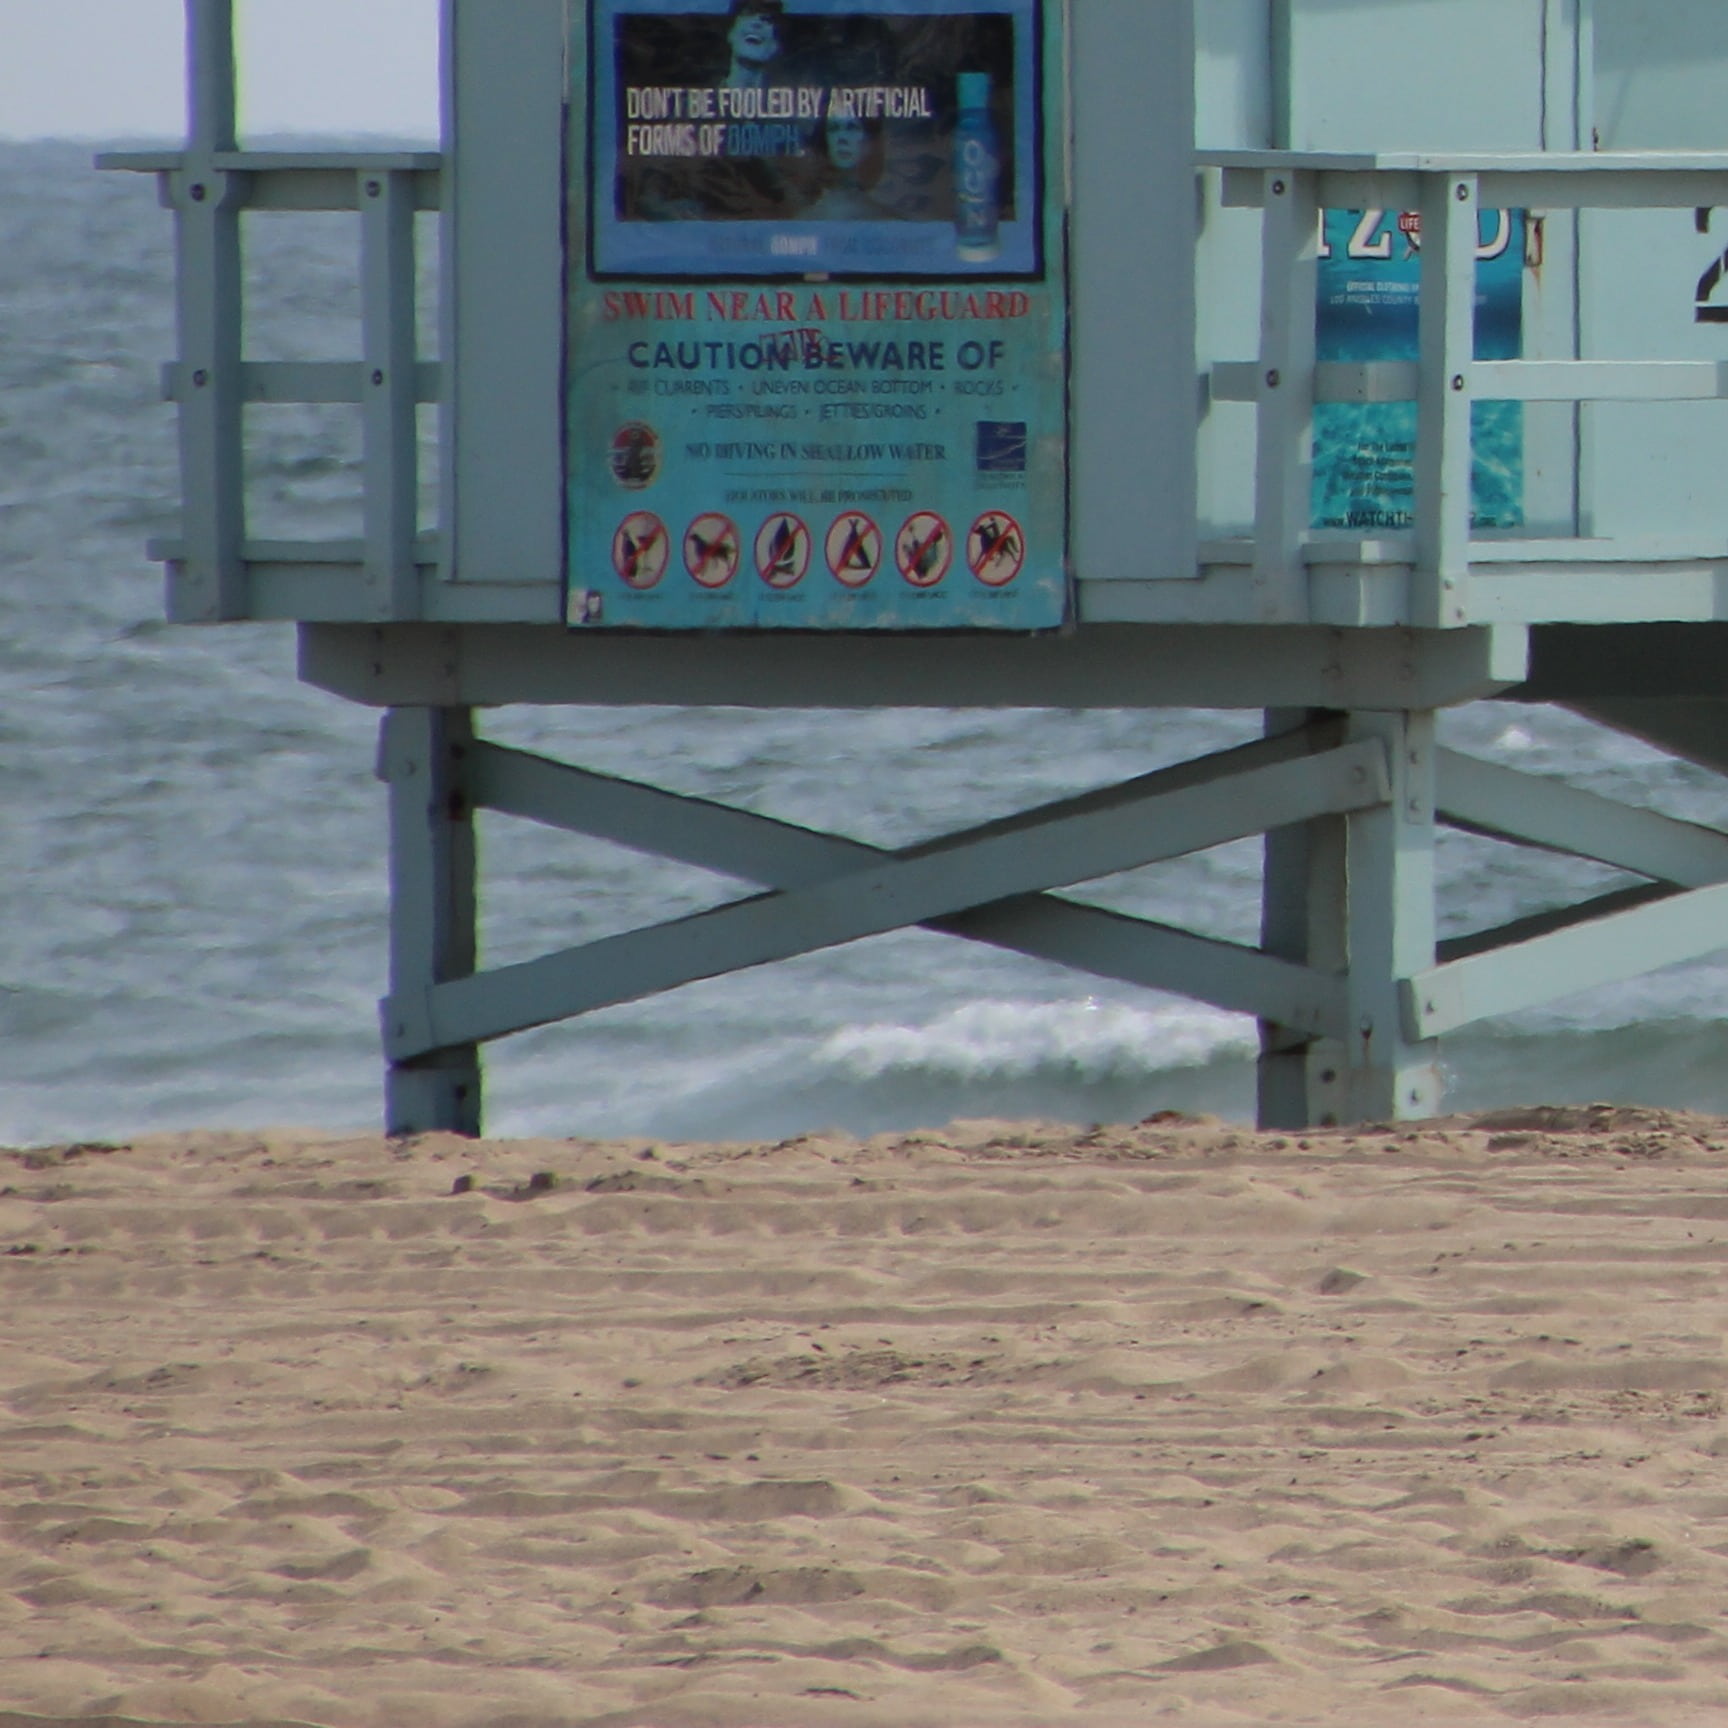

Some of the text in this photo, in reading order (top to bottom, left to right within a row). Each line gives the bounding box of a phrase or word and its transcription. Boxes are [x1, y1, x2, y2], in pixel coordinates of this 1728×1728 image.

[626, 87, 931, 119] DON'T BE FOOLED BY ARTIFICIAL
[627, 124, 695, 157] FORMS
[700, 124, 726, 157] OF
[603, 290, 1030, 321] SWIM NEAR A LIFEGUARD
[627, 340, 791, 370] CAUTION
[803, 340, 945, 370] BEWARE
[956, 339, 1005, 370] OF
[752, 379, 809, 395] UNEVEN
[813, 379, 867, 395] OCEAN
[871, 379, 933, 395] BOTTOM
[780, 442, 797, 460] IN
